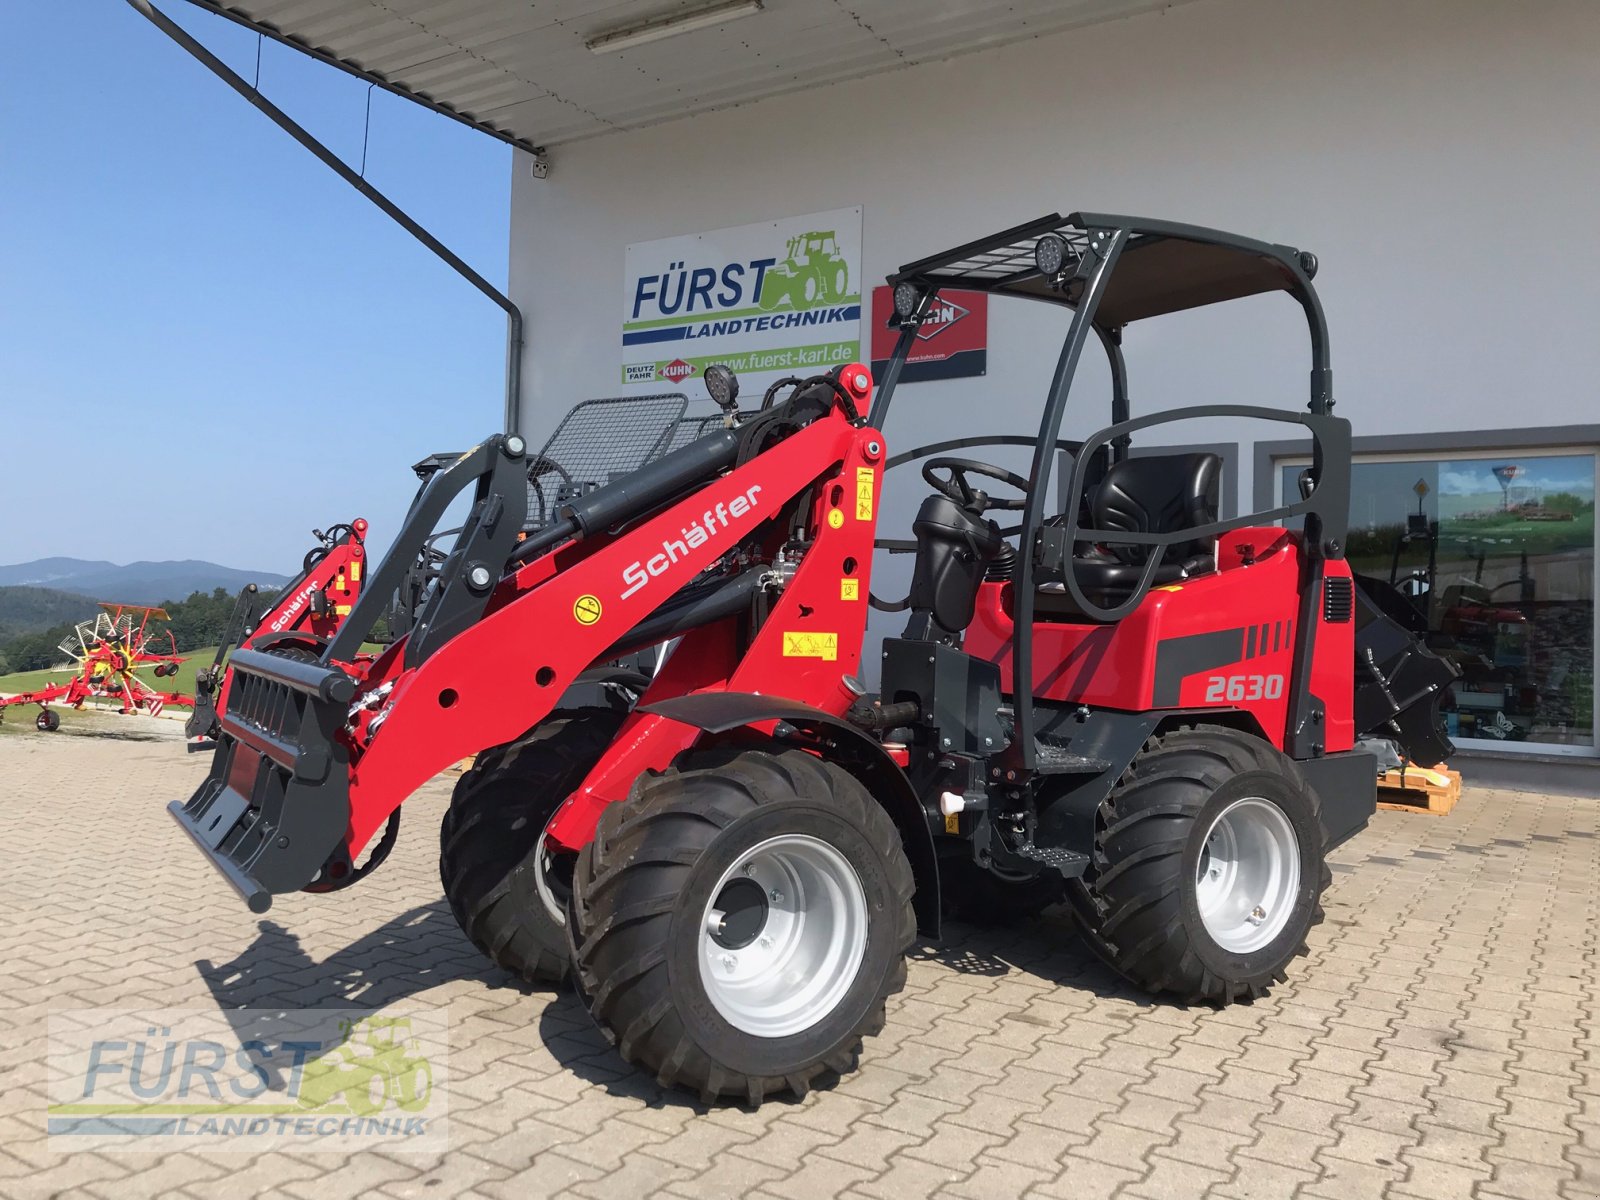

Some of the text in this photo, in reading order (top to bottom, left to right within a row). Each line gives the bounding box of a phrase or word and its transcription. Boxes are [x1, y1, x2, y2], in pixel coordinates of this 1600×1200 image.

[632, 257, 776, 319] FÜRST
[685, 307, 846, 340] LANDTECHNIK
[626, 365, 655, 373] DEUTZ
[629, 372, 652, 380] FAHR
[662, 365, 693, 376] KUHN
[620, 484, 762, 600] Schäffer
[270, 580, 318, 632] Schäffer
[1205, 674, 1284, 703] 2630
